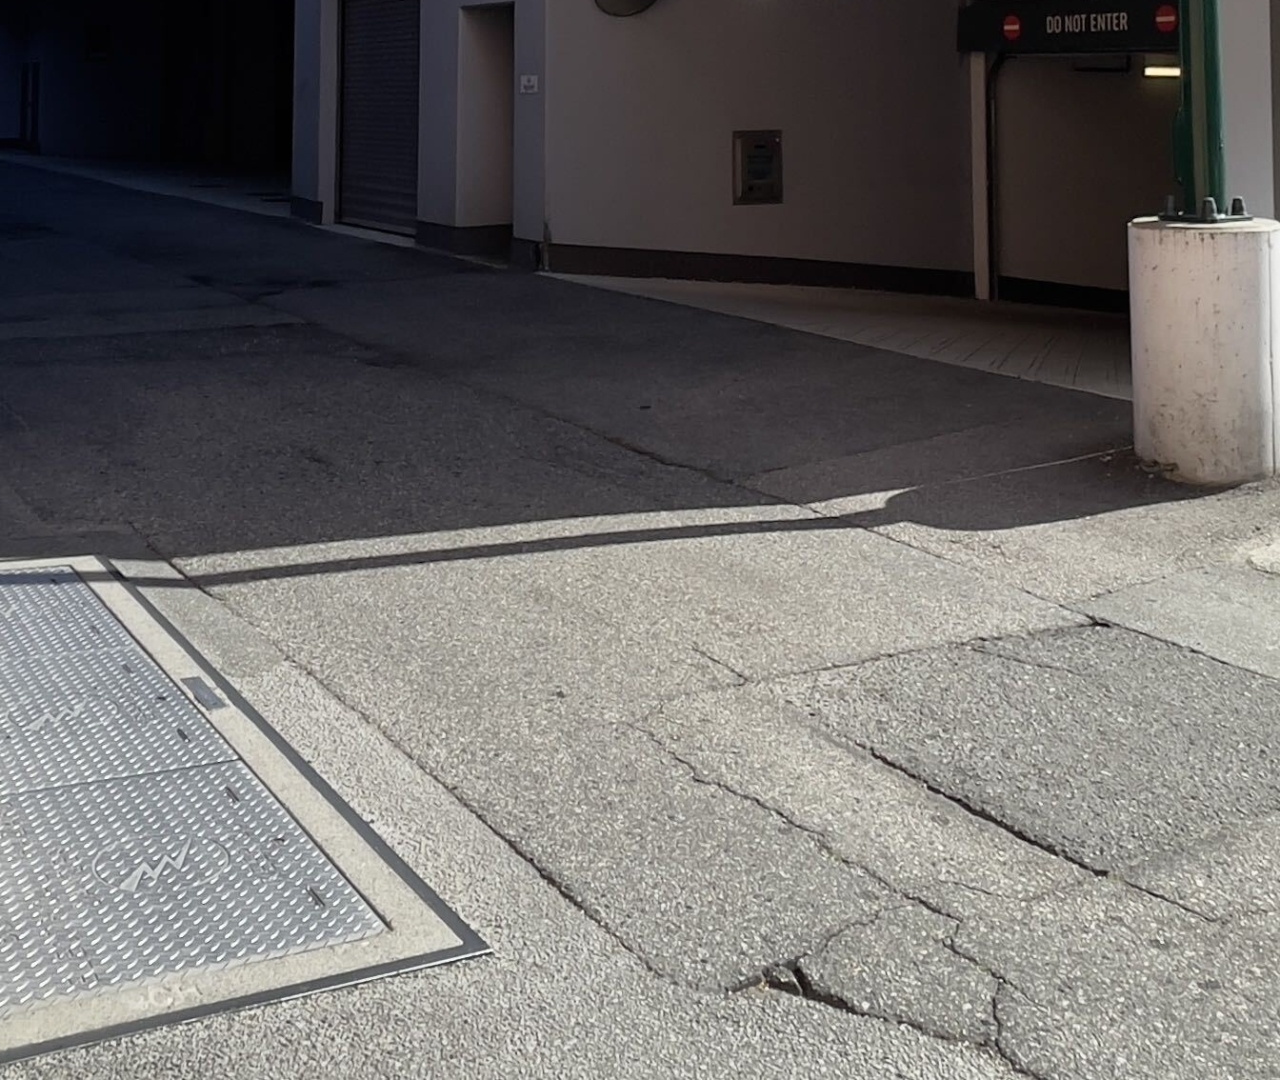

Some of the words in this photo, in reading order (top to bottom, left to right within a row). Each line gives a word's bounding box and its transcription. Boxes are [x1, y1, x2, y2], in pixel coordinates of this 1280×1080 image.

[1047, 16, 1062, 34] DO
[1065, 14, 1086, 33] NOT
[1090, 13, 1128, 31] ENTER
